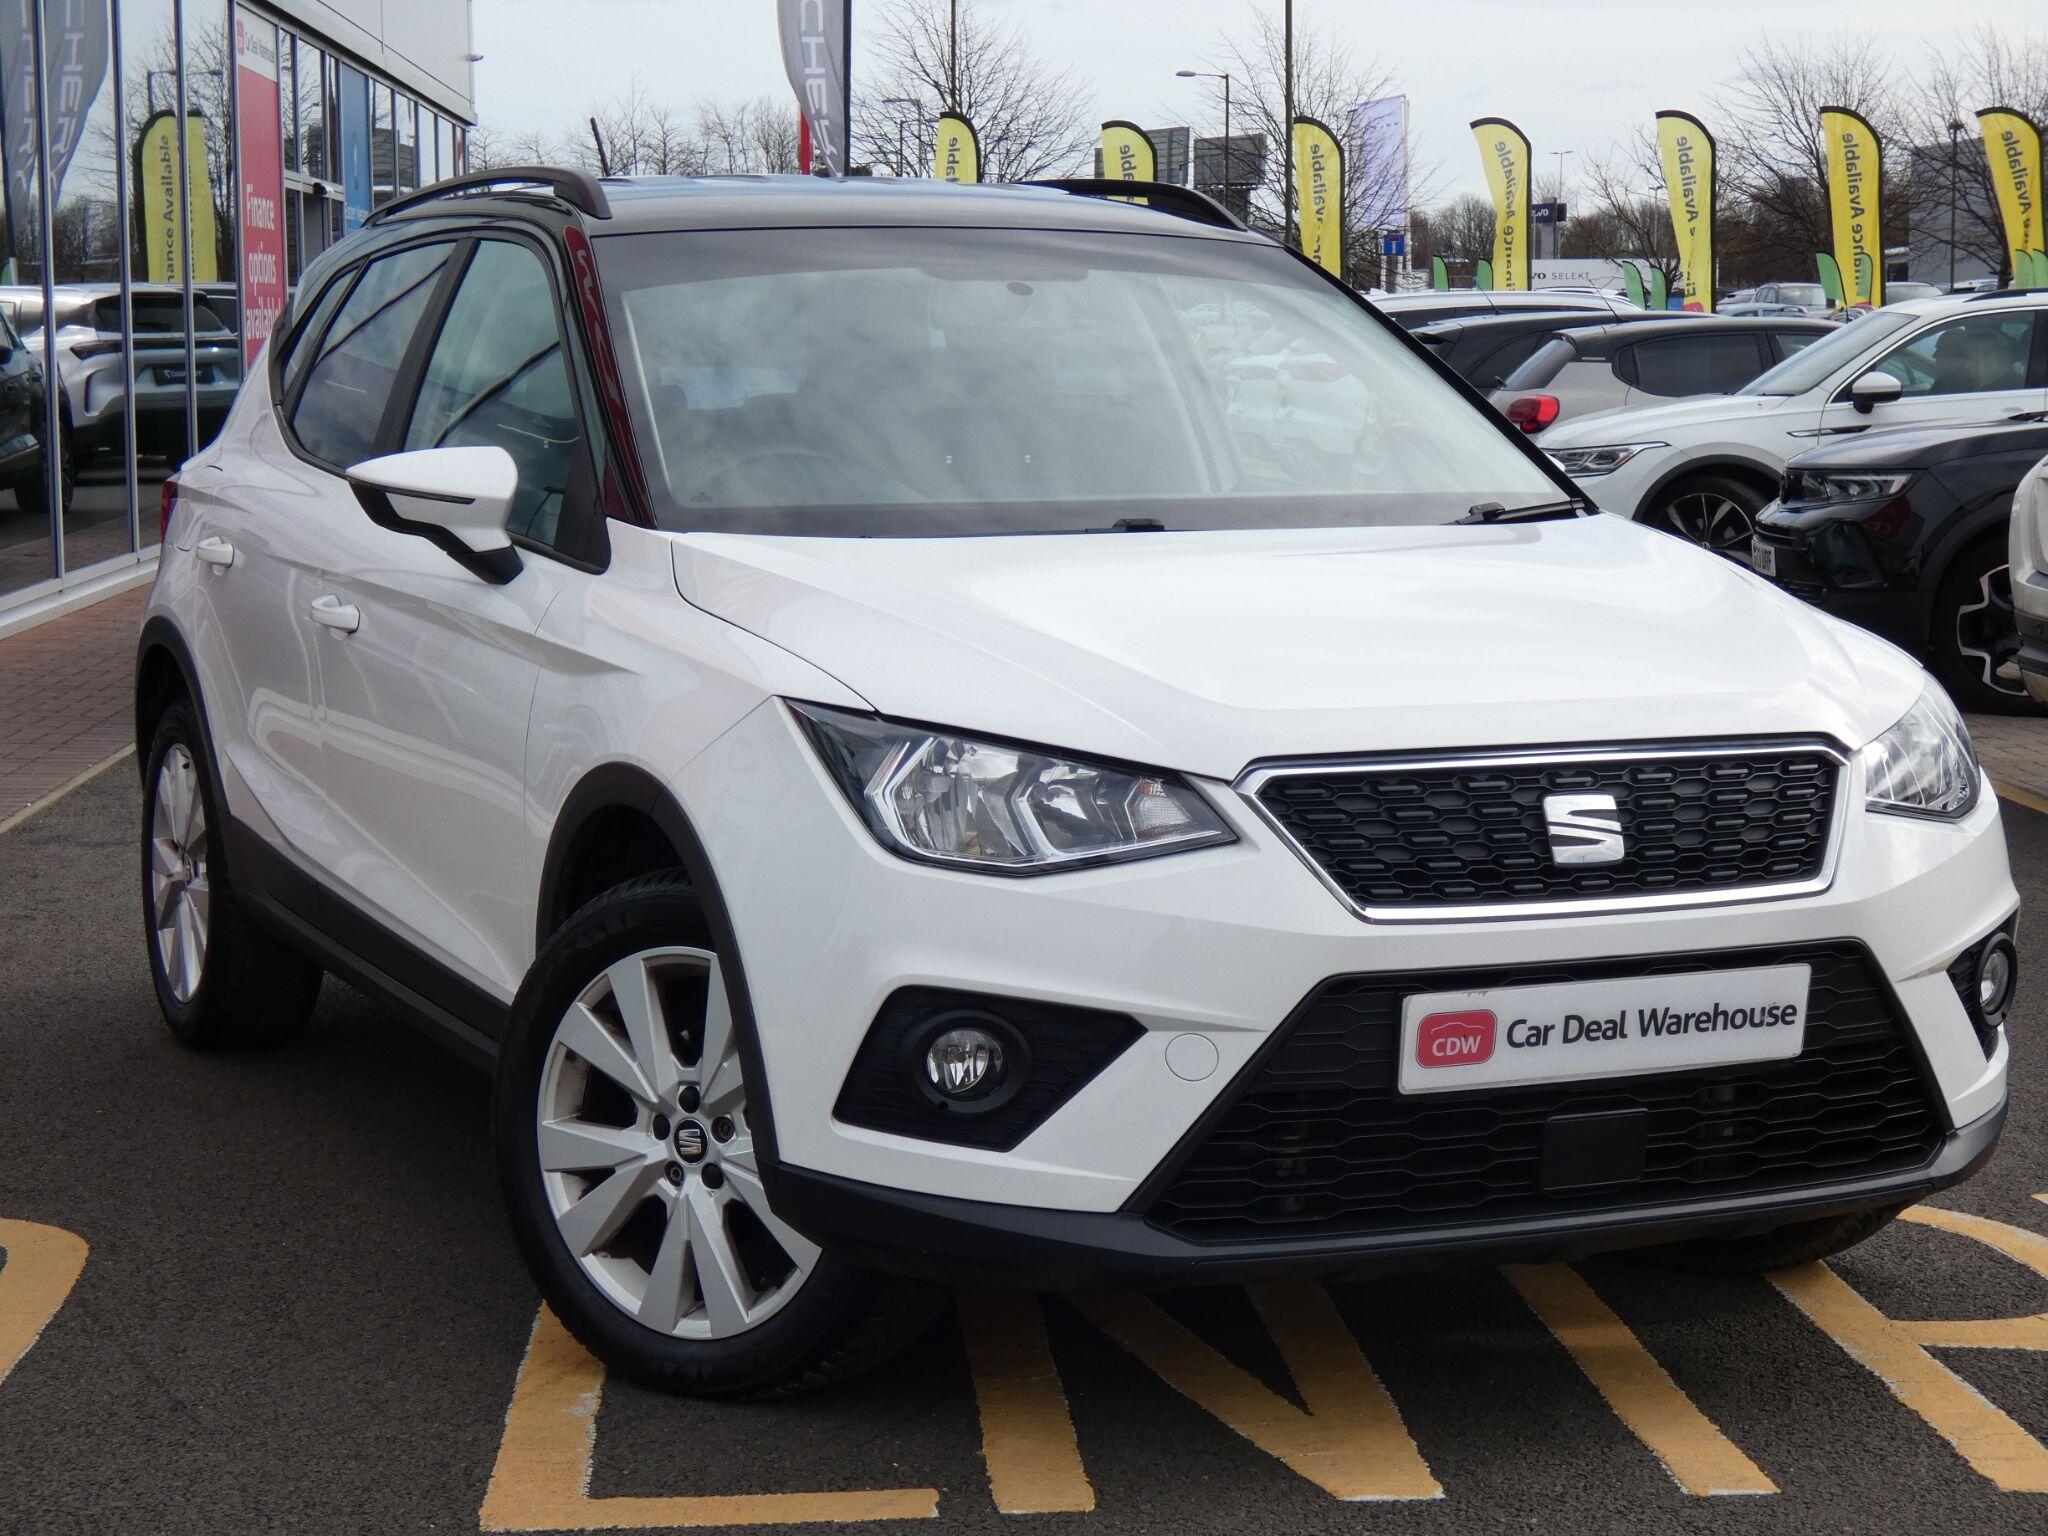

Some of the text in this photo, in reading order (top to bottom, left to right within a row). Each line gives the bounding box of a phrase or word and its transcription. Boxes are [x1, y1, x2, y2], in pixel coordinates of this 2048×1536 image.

[160, 135, 175, 222] Available
[246, 183, 275, 231] Finance
[249, 241, 276, 296] options
[1551, 272, 1590, 280] SELEKT
[1432, 1035, 1481, 1058] CDW
[1506, 1001, 1798, 1049] Car Deal Warehouse
